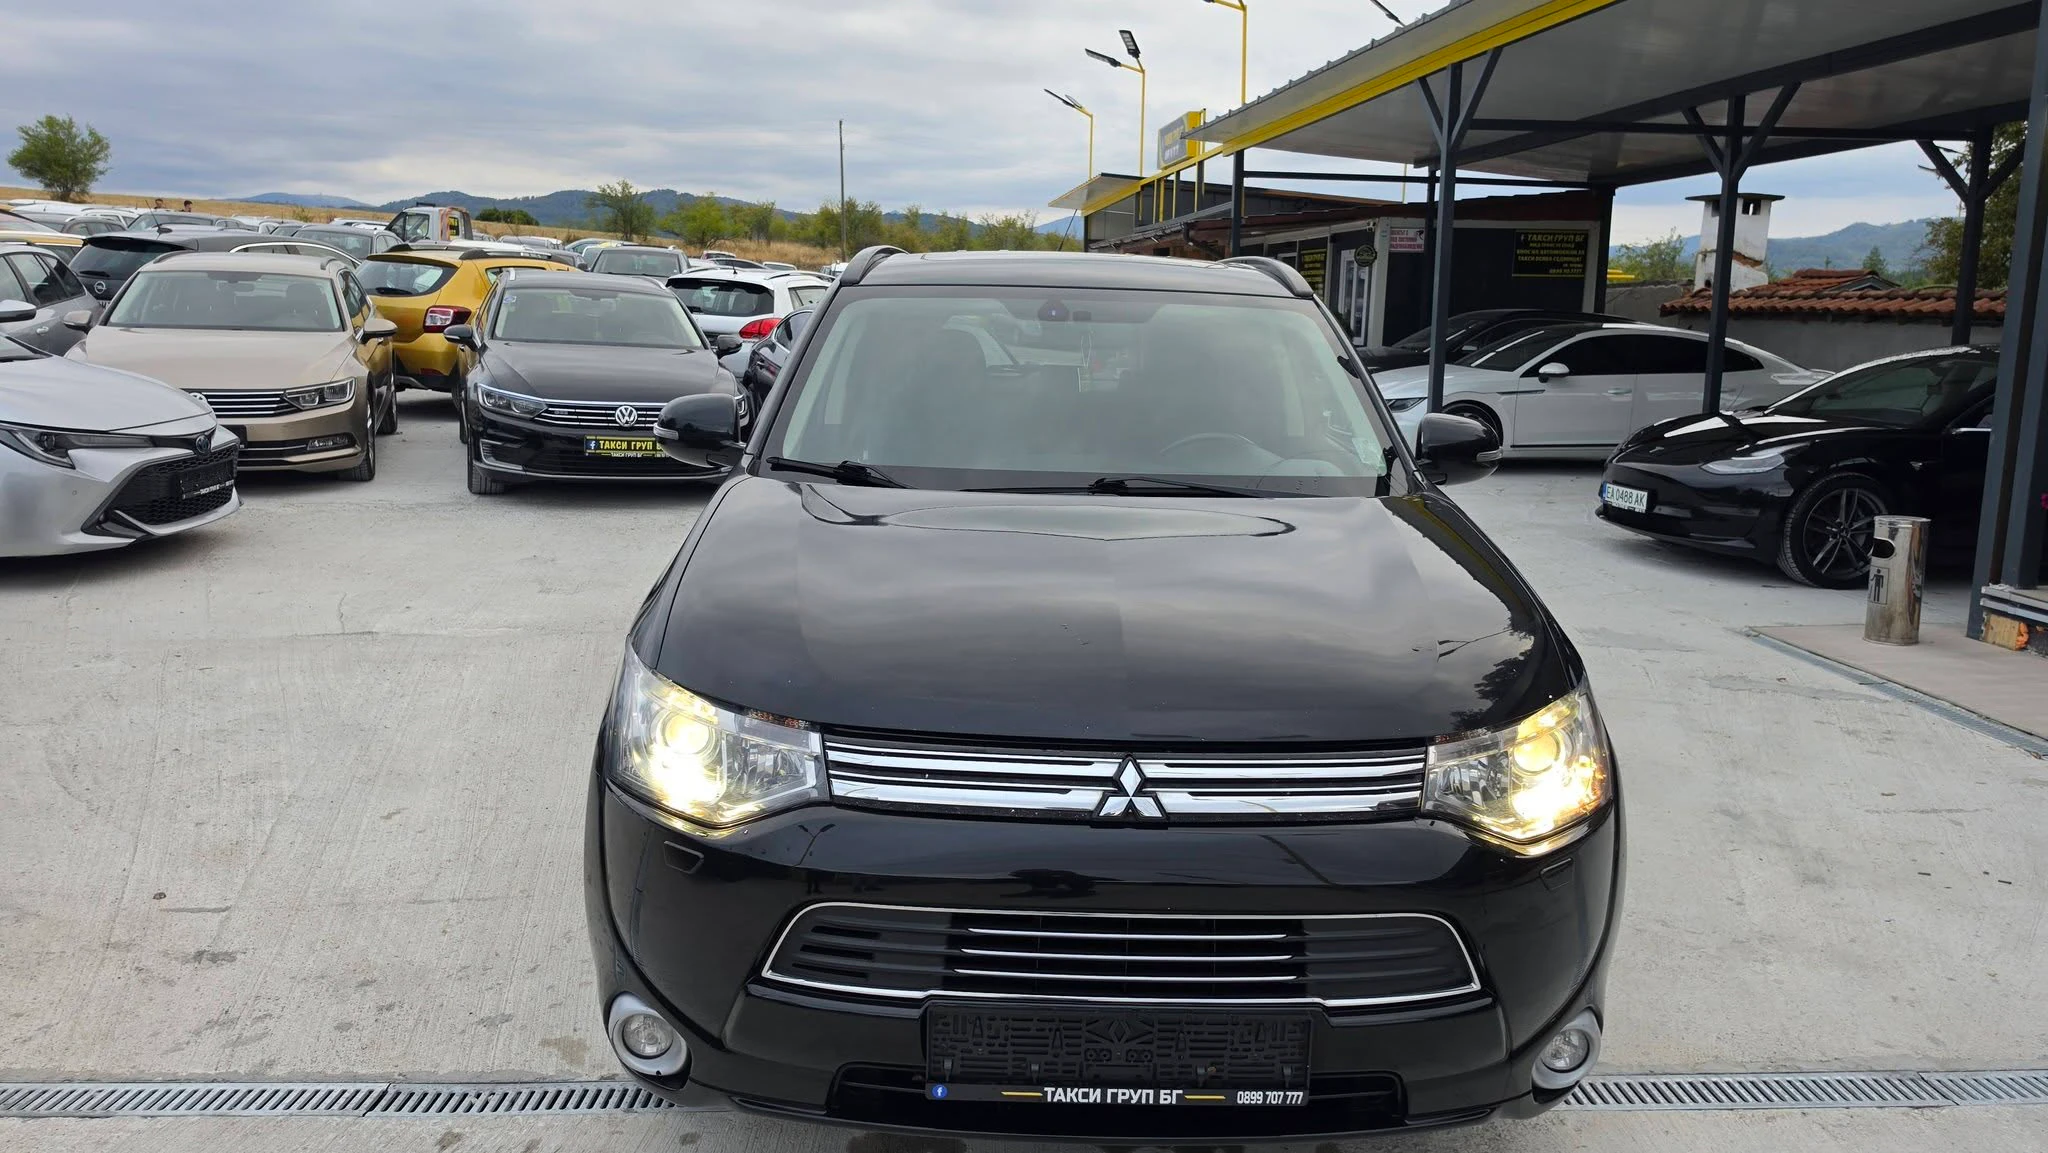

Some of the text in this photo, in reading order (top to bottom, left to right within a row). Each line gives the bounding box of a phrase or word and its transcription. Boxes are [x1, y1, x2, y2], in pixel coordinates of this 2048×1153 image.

[1527, 234, 1553, 242] ТАКСИ
[1554, 234, 1574, 242] ГРУП
[599, 440, 628, 450] ТАКСИ
[631, 441, 653, 450] ГРУП
[1607, 486, 1645, 507] EA 0488 AK
[1044, 1087, 1101, 1103] ТАКСИ
[1106, 1088, 1154, 1105] ГРУП
[1159, 1089, 1183, 1105] БГ
[1237, 1091, 1263, 1105] 0899
[1265, 1091, 1283, 1105] 707
[1286, 1091, 1304, 1105] 777
